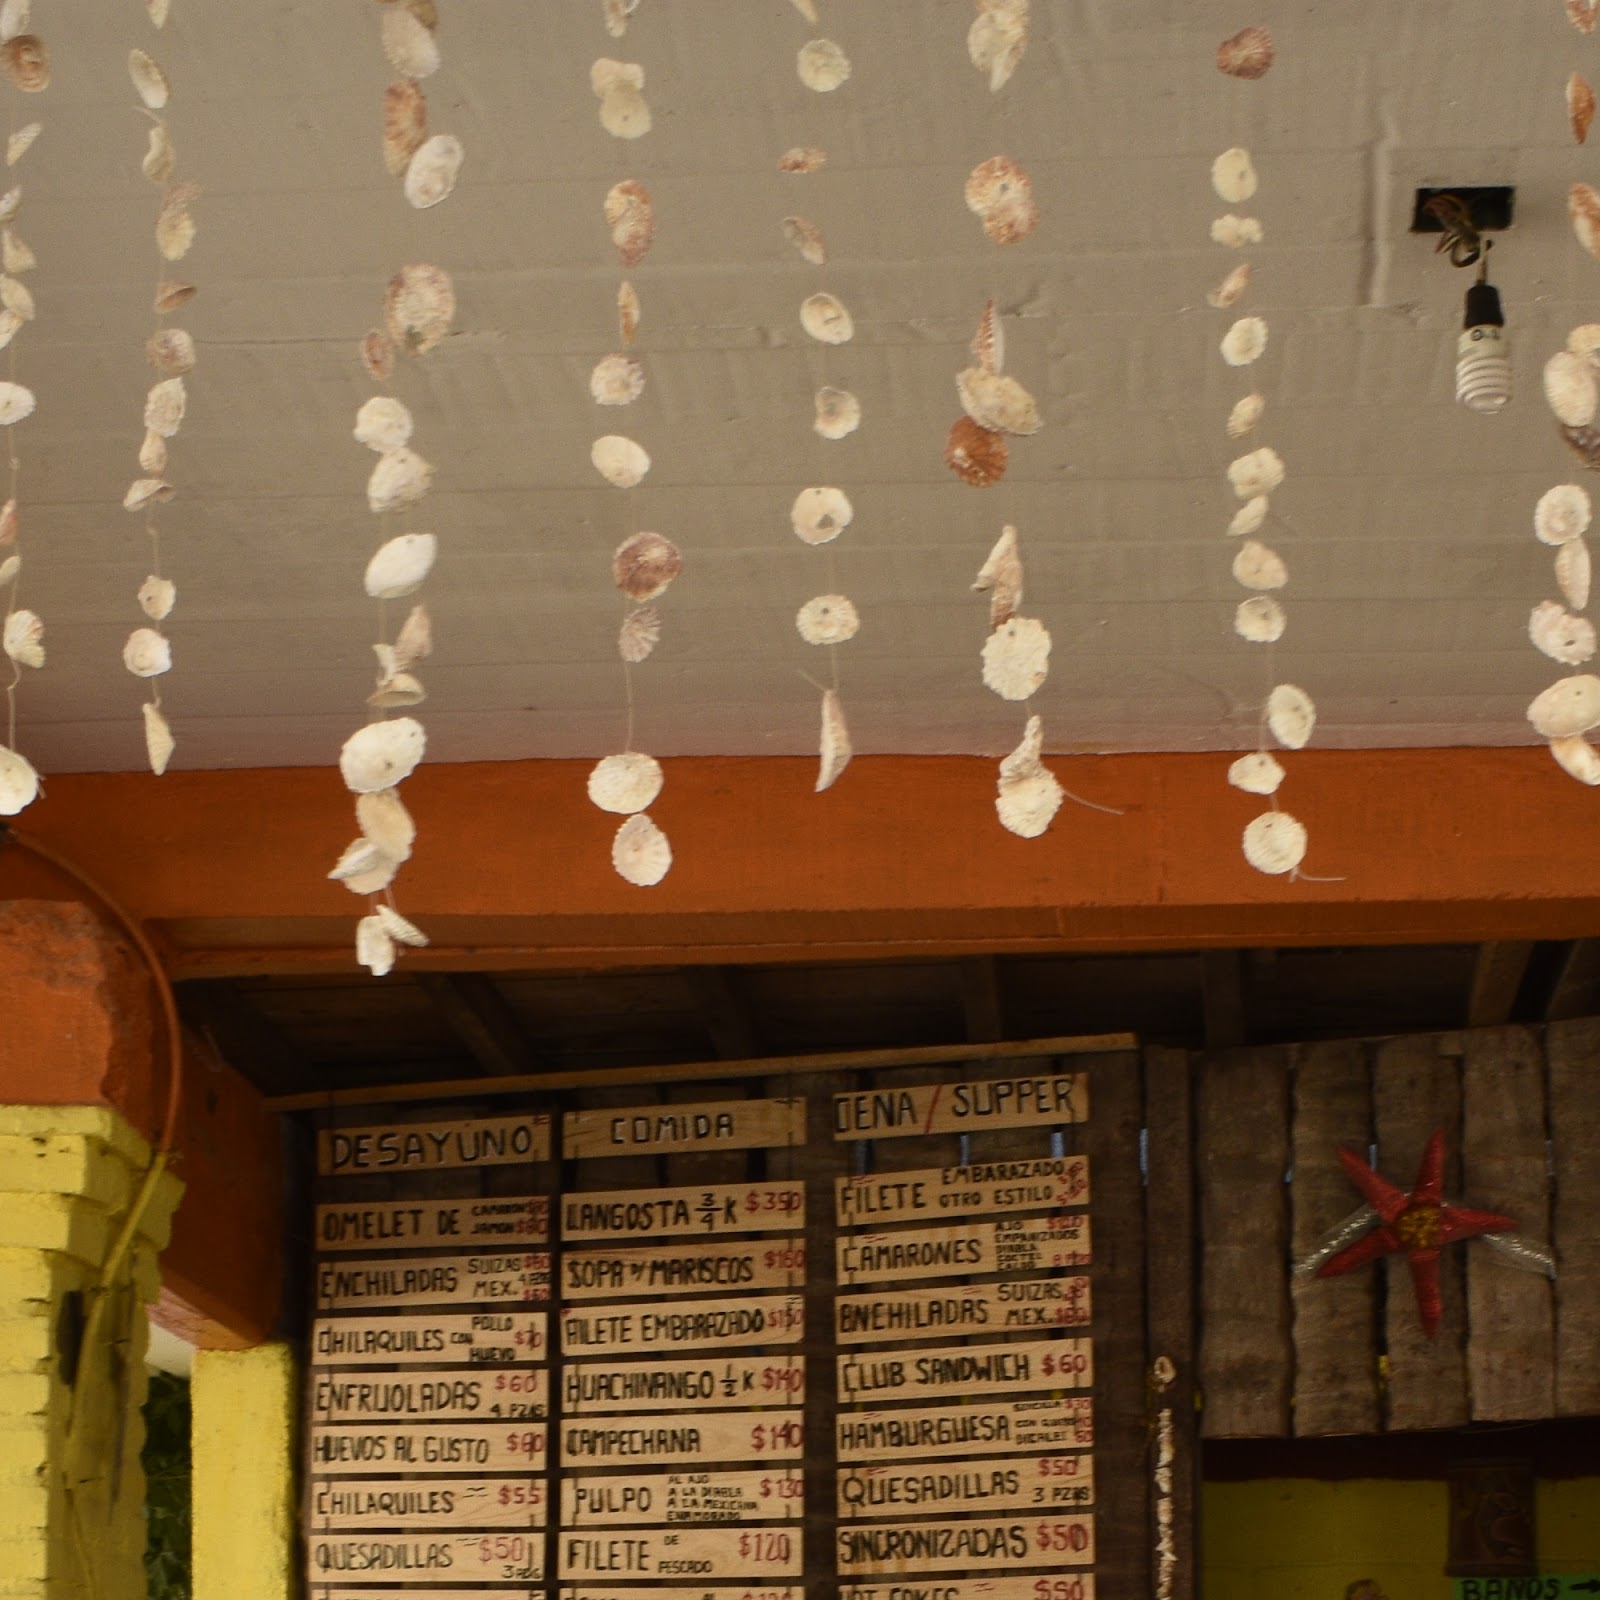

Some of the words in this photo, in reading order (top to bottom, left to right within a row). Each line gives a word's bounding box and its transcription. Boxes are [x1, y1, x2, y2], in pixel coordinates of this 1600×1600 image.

[835, 1091, 918, 1132] CENA
[952, 1079, 1075, 1118] SUPPER
[610, 1113, 733, 1145] COMIDA
[331, 1126, 532, 1169] DESAYUNO
[941, 1160, 1066, 1186] EMBARAZADO
[841, 1181, 927, 1216] FILETE
[938, 1191, 982, 1209] OTRO
[993, 1185, 1053, 1206] ESTILO
[324, 1209, 424, 1241] OMELET
[437, 1209, 461, 1236] DE
[566, 1199, 689, 1232] LANGOSTA
[468, 1258, 520, 1275] SUIZAS
[843, 1239, 982, 1273] CAMARONES
[319, 1267, 458, 1299] ENCHILADAS
[568, 1259, 623, 1289] SOPA
[649, 1256, 753, 1287] MARISCOS
[998, 1281, 1063, 1302] SUIZAS
[471, 1316, 514, 1332] POLLO
[641, 1309, 764, 1341] EMBARAZADO
[318, 1329, 445, 1355] CHILAQUILES
[494, 1374, 538, 1393] $60
[566, 1370, 713, 1403] HUACHINANGO
[842, 1360, 907, 1392] CLUB
[915, 1353, 1030, 1386] SANDWICH
[1041, 1352, 1088, 1378] $60
[566, 1427, 702, 1456] CAMPECHANA
[839, 1415, 1010, 1450] HAMBURGUESA
[314, 1436, 388, 1463] HUEVOS
[394, 1436, 418, 1462] AL
[423, 1436, 490, 1464] GUSTO
[316, 1491, 455, 1516] CHILAQUILES
[498, 1485, 541, 1505] $55
[575, 1486, 653, 1514] PULPO
[842, 1470, 1020, 1508] QUESADILLAS
[315, 1543, 454, 1571] QUESADILLAS
[480, 1536, 524, 1566] $50
[566, 1538, 649, 1572] FILETE
[663, 1535, 679, 1546] DE
[840, 1524, 1027, 1564] SINCRONIZADAS
[657, 1560, 713, 1574] PESCADO
